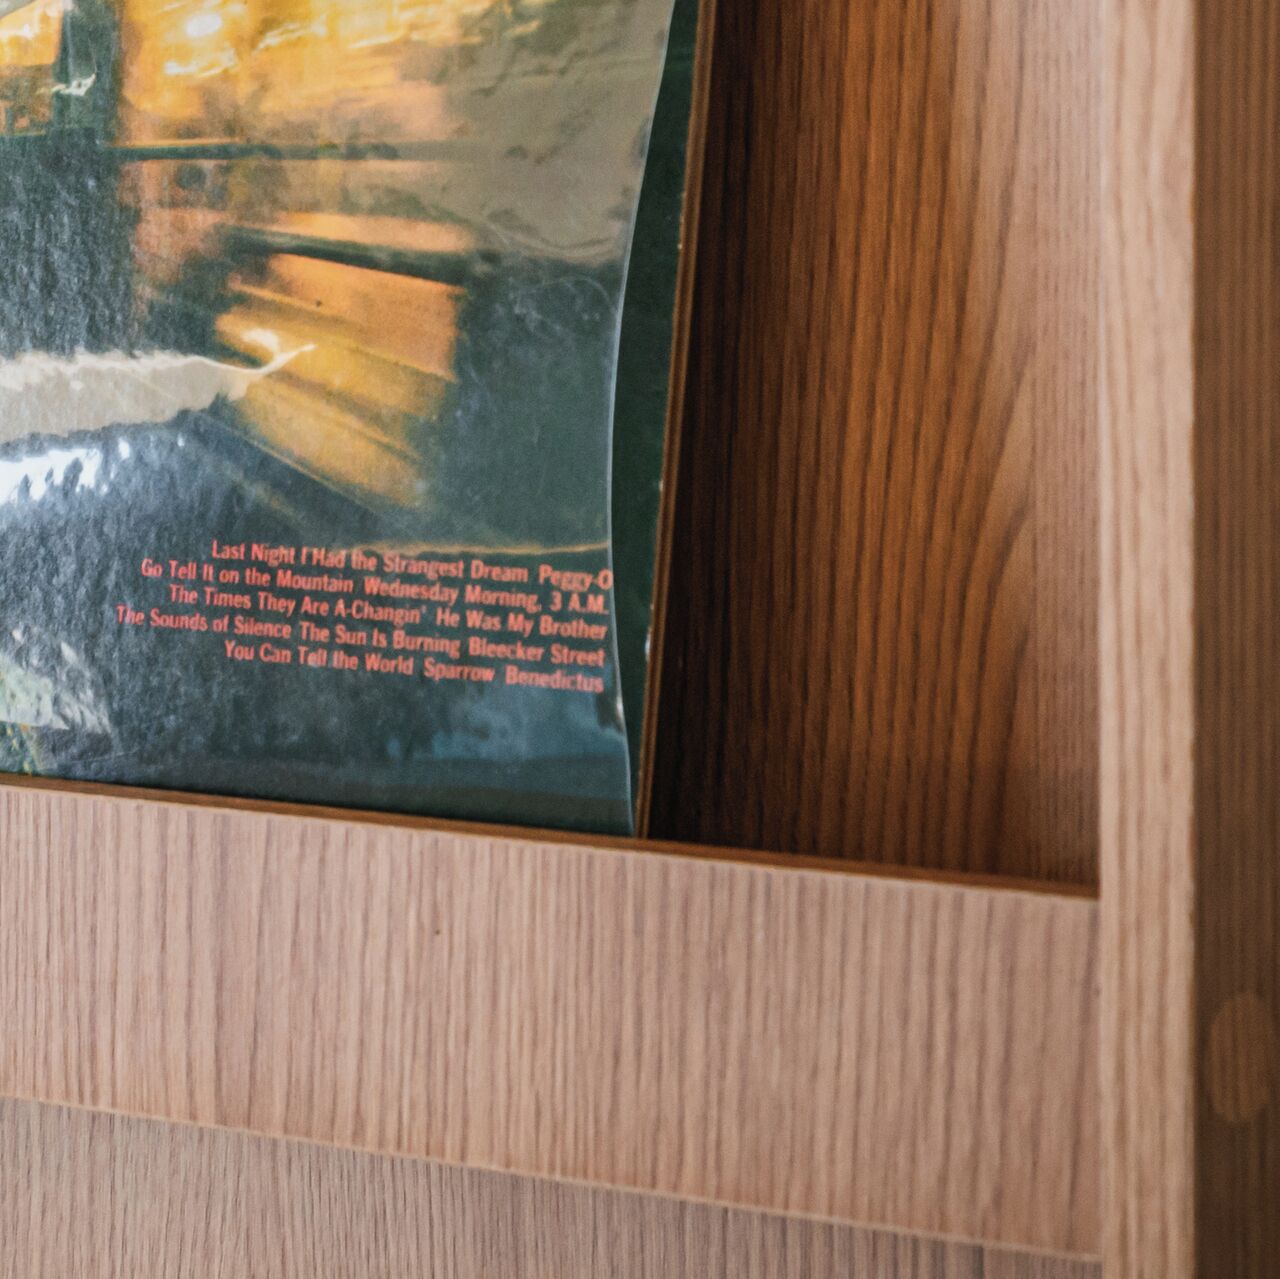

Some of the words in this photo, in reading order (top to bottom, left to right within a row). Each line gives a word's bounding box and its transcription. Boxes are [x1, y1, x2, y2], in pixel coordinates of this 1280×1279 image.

[141, 557, 164, 578] Go
[169, 560, 197, 581] Tell
[202, 563, 214, 582] It
[219, 569, 240, 584] on
[245, 567, 271, 587] the
[276, 569, 354, 594] Mountain
[363, 576, 460, 607] Wednesday
[465, 584, 543, 614] Morning,
[550, 591, 563, 612] 3
[568, 593, 610, 615] A.M.
[211, 538, 246, 560] Last
[251, 543, 296, 568] Night
[301, 547, 309, 565] I
[311, 548, 347, 569] Had
[351, 551, 377, 571] the
[383, 553, 465, 581] Strangest
[470, 559, 529, 583] Dream
[538, 563, 613, 593] Peggy-O
[116, 604, 146, 626] The
[150, 608, 209, 632] Sounds
[212, 614, 229, 632] of
[234, 616, 293, 640] Silence
[300, 621, 330, 643] The
[335, 624, 368, 646] Sun
[372, 627, 387, 648] Is
[393, 629, 462, 660] Burning
[468, 636, 545, 662] Bleecker
[550, 643, 606, 669] Street
[169, 583, 199, 604] The
[204, 586, 252, 609] Times
[258, 591, 296, 618] They
[301, 596, 330, 616] Are
[334, 598, 427, 626] A-Changin'
[436, 607, 460, 628] He
[466, 609, 503, 631] Was
[508, 612, 534, 638] My
[540, 614, 609, 640] Brother
[224, 639, 255, 661] You
[259, 643, 291, 664] Can
[298, 645, 328, 668] Tell
[333, 650, 359, 671] the
[365, 653, 415, 676] World
[423, 656, 496, 683] Sparrow
[505, 664, 605, 694] Benedictus
